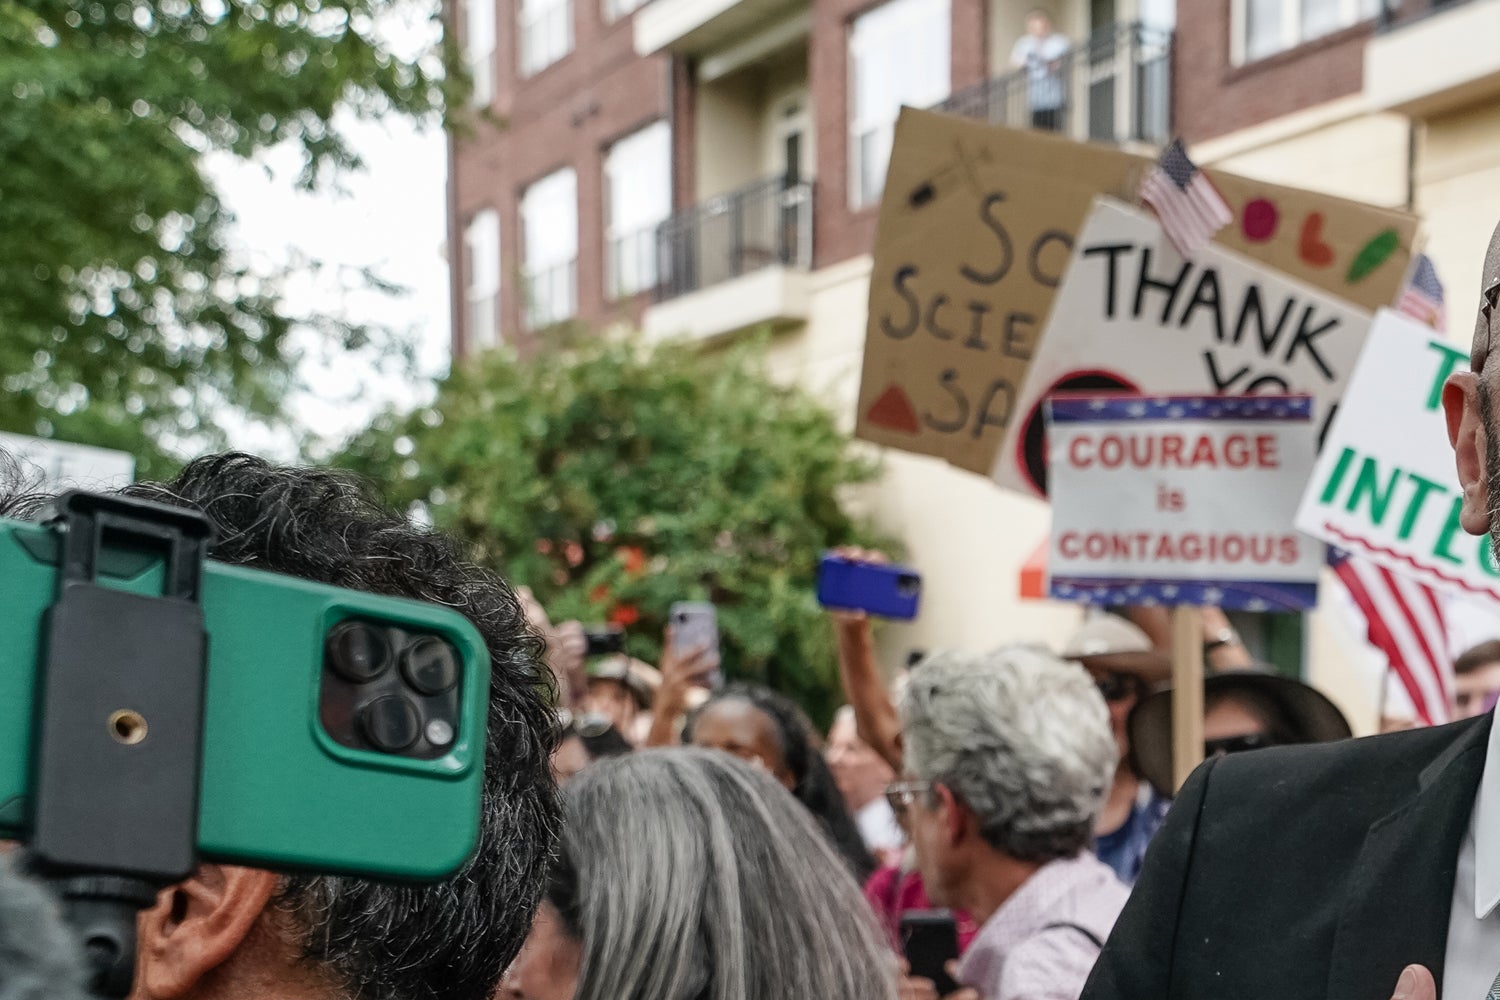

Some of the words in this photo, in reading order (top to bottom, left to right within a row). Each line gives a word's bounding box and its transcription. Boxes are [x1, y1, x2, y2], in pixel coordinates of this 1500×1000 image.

[1084, 245, 1342, 382] THANK
[1068, 432, 1280, 471] COURAGE
[1156, 480, 1186, 513] is
[1058, 531, 1300, 565] CONTAGIOUS
